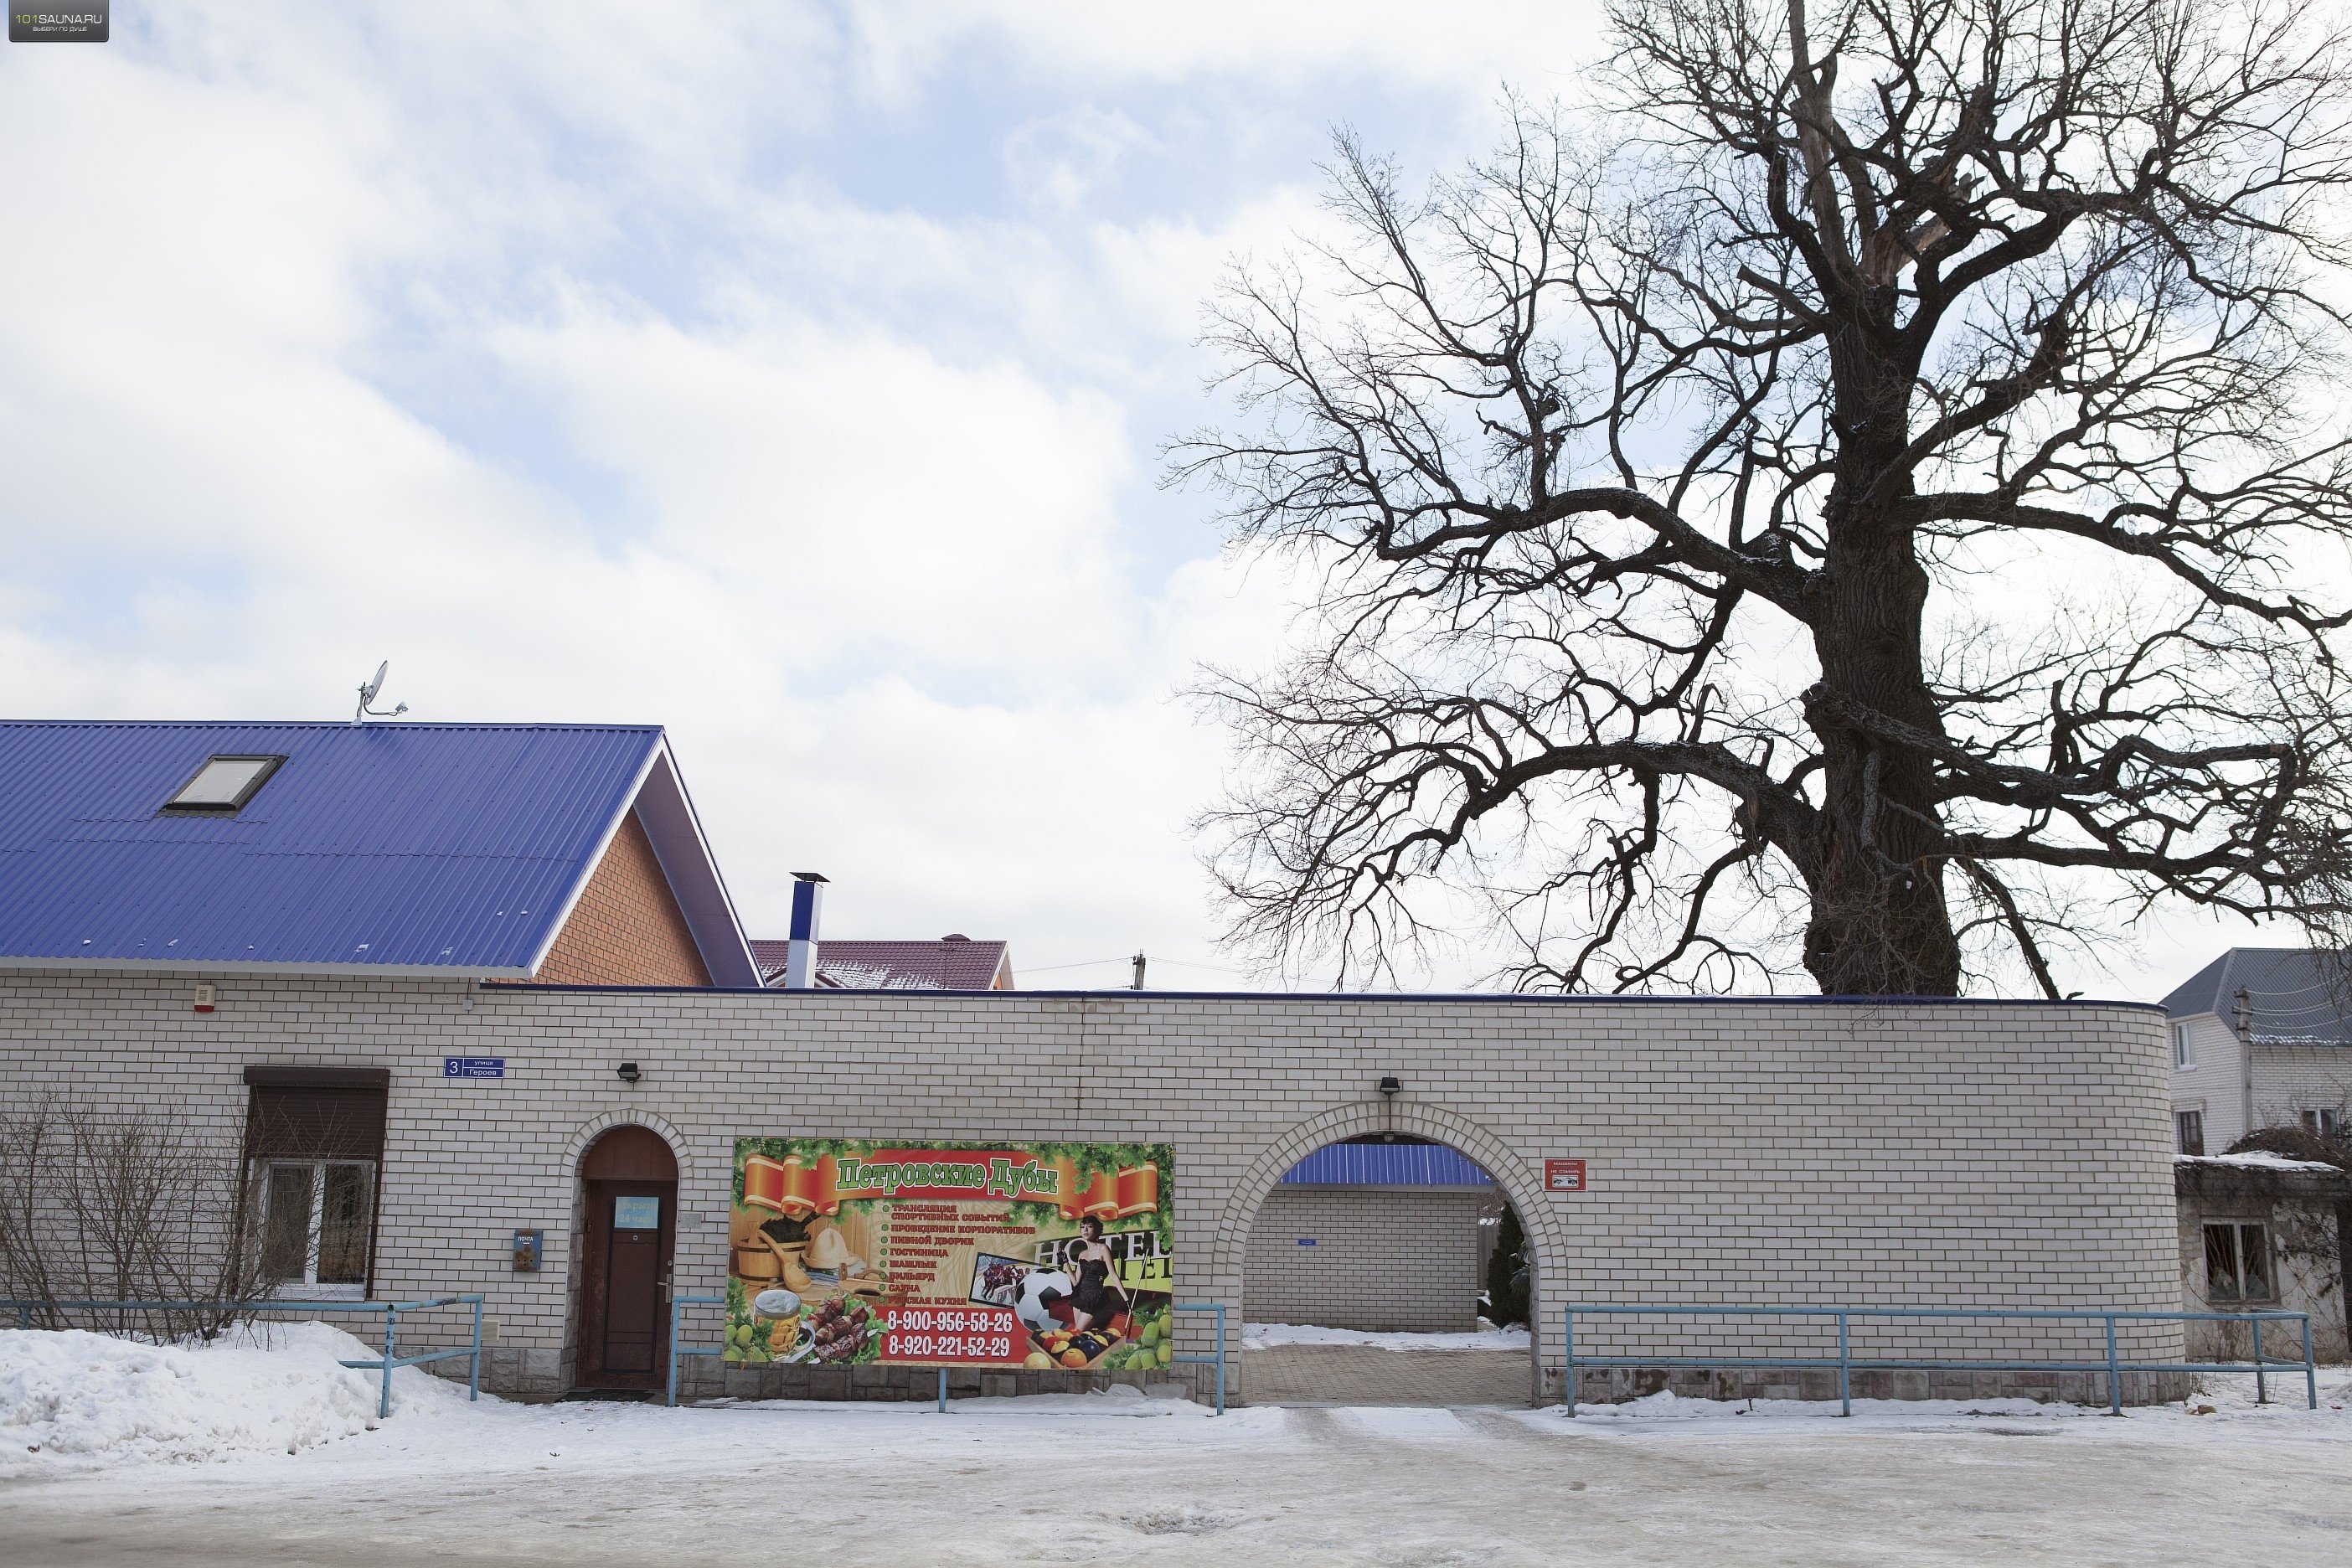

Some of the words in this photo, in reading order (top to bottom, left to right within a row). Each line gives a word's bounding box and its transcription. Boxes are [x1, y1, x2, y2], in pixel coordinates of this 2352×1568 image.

[449, 1061, 458, 1074] 3
[836, 1158, 987, 1194] Петровские
[988, 1158, 1059, 1198] Дубы
[891, 1204, 957, 1213] ТРАНСЛЯЦИЯ
[620, 1214, 630, 1223] 24
[891, 1213, 959, 1221] СПОРТИВНЫХ
[962, 1212, 1010, 1222] СОБЫТИЙ
[891, 1224, 956, 1234] ПРОВЕДЕНИЕ
[957, 1225, 1036, 1235] КОРПОРАТИВОВ
[890, 1235, 932, 1245] ПИВНОЙ
[934, 1237, 974, 1246] ДВОРИК
[890, 1248, 949, 1258] ГОСТИНИЦА
[890, 1260, 937, 1268] ШАШЛЫК
[889, 1272, 935, 1282] БИЛЬЯРД
[888, 1284, 921, 1292] САУНА
[888, 1310, 1013, 1332] 8-900-956-58-26
[889, 1335, 1010, 1357] 8-920-221-52-29
